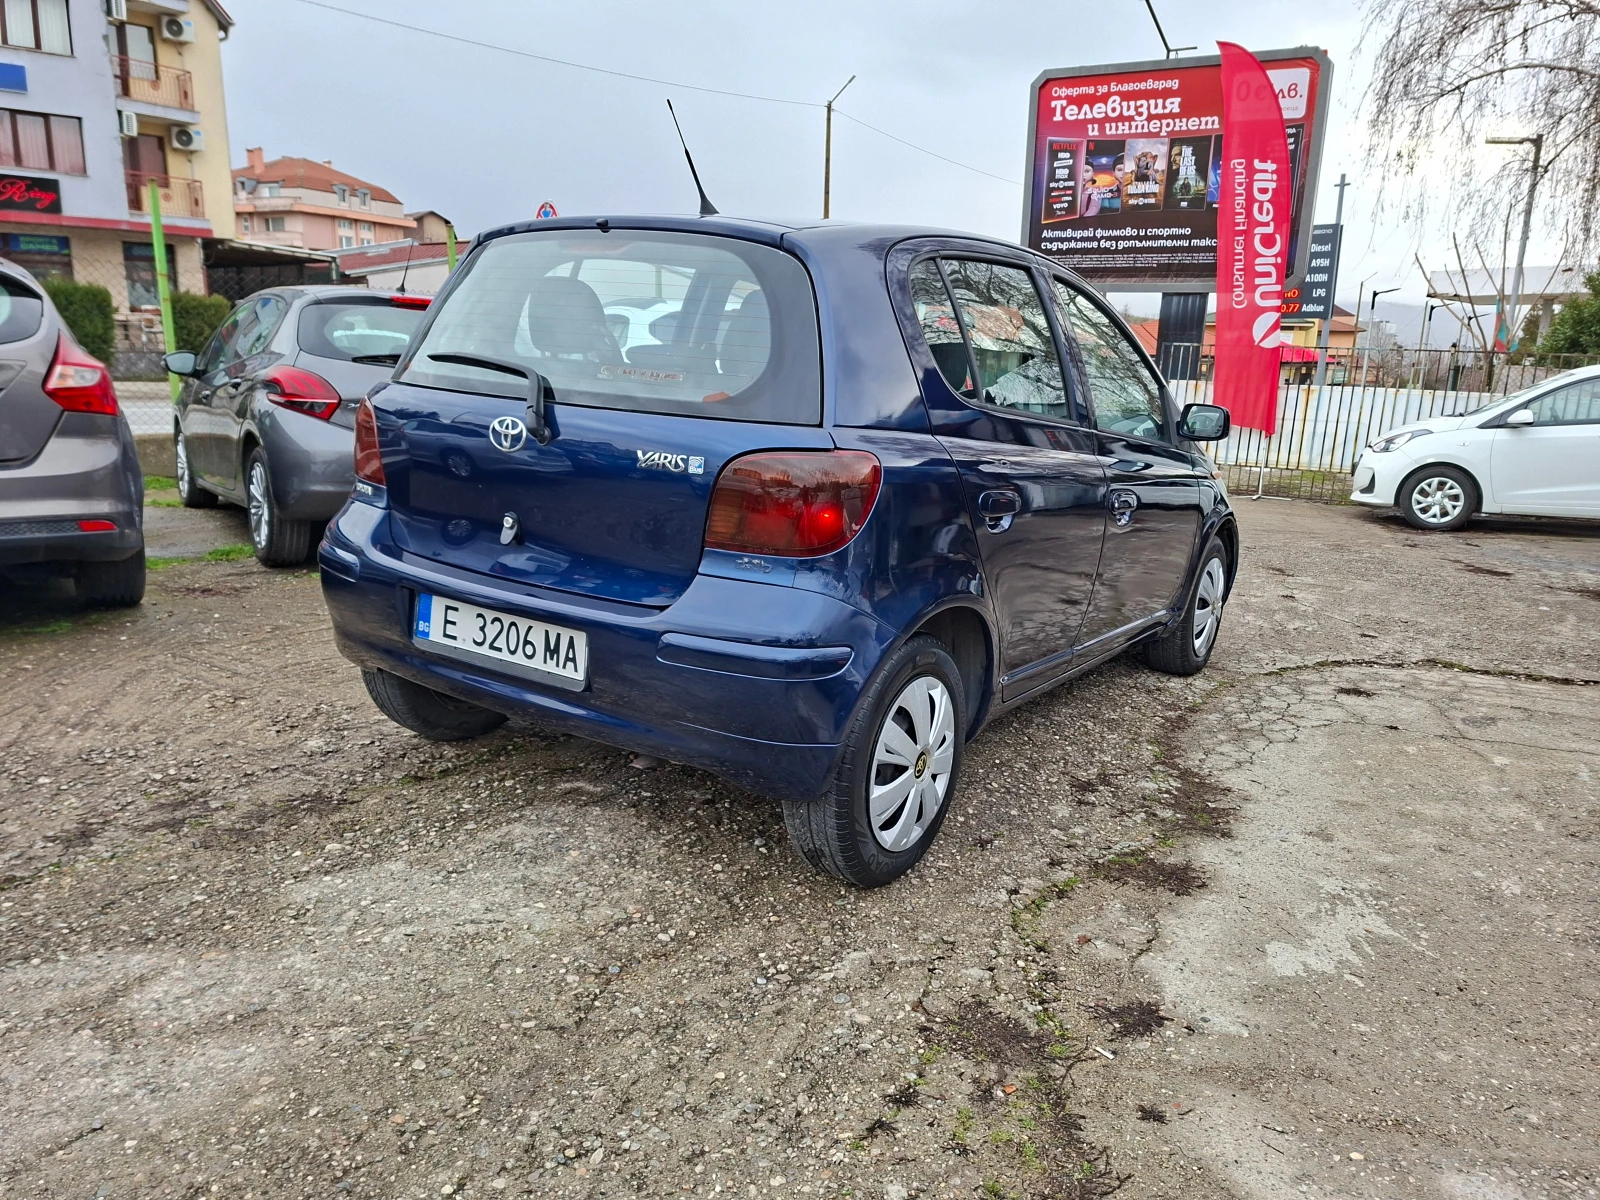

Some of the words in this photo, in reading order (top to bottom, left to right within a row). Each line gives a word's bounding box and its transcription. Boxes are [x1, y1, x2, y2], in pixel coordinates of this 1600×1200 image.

[1052, 84, 1095, 98] Оферта
[1096, 85, 1108, 96] за
[1110, 79, 1179, 93] Благоевград
[1051, 96, 1181, 122] Телевизия
[1087, 124, 1099, 136] и
[1105, 116, 1220, 136] интернет
[1053, 142, 1077, 150] NETFLIX
[1181, 147, 1193, 157] THE
[1180, 156, 1196, 166] LAST
[1042, 228, 1093, 240] Активирай
[1095, 227, 1138, 239] филмово
[1139, 228, 1146, 236] и
[1147, 227, 1191, 238] спортно
[1041, 240, 1099, 250] съдържание
[1099, 239, 1116, 250] без
[1117, 238, 1189, 250] допълнителни
[1191, 237, 1218, 247] такс
[1311, 243, 1331, 252] Diesel
[1311, 258, 1330, 267] A95H
[1305, 273, 1328, 283] A100H
[1312, 288, 1326, 297] LPG
[1281, 303, 1300, 313] 0.77
[1301, 303, 1324, 312] Adblue
[637, 449, 687, 472] YARIS
[418, 620, 430, 633] BG
[442, 604, 459, 641] E
[472, 613, 537, 660] 3206
[543, 629, 578, 673] MA
